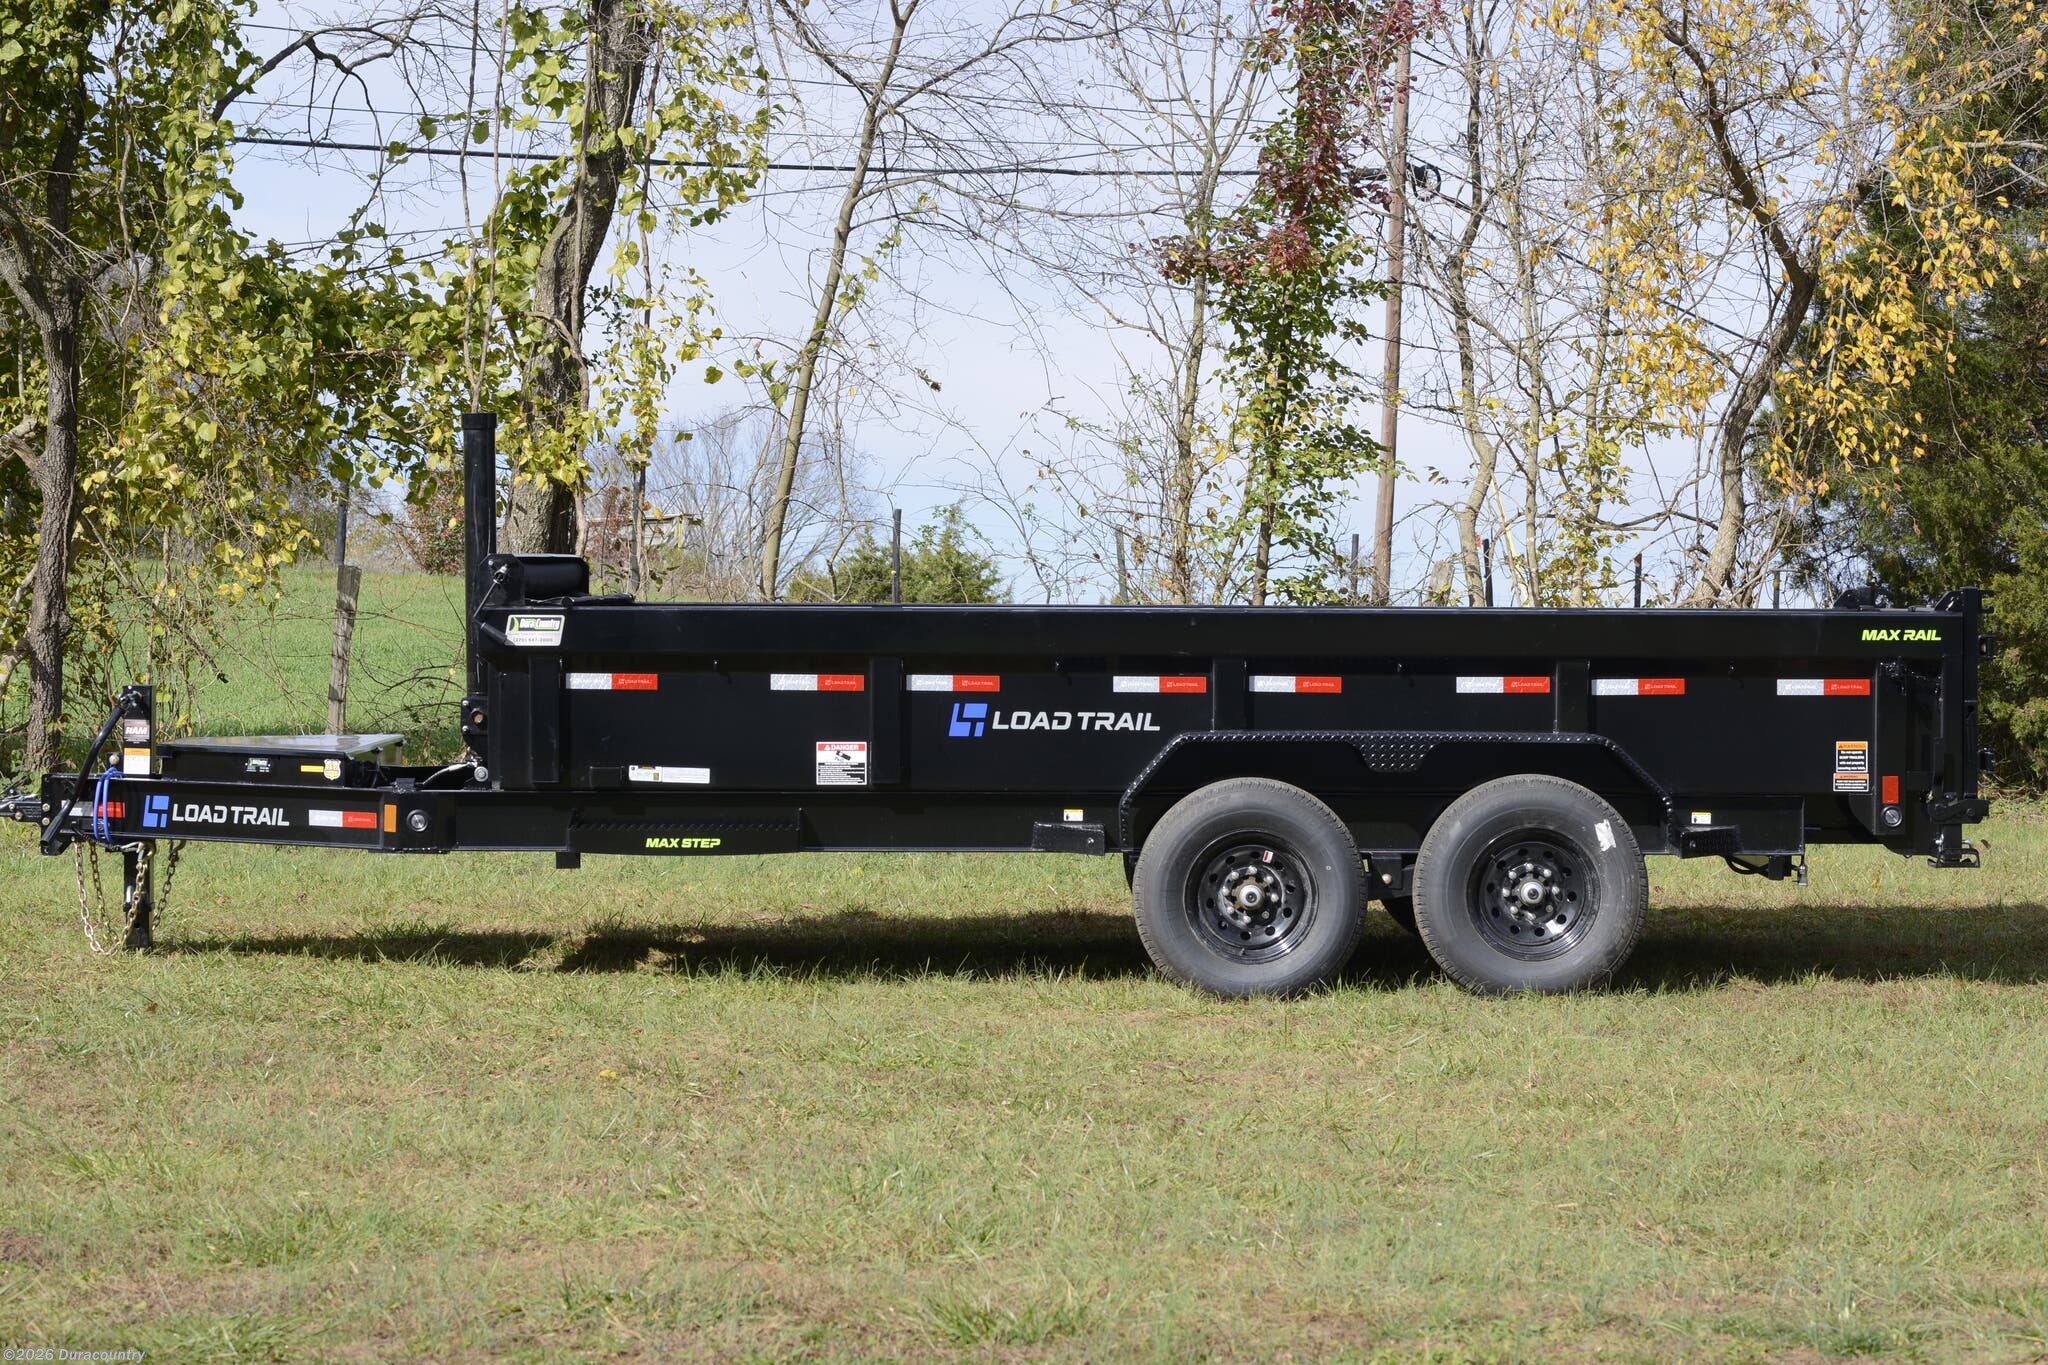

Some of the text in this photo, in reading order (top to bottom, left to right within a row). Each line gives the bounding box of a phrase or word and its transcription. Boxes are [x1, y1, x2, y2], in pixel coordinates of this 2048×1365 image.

[1862, 630, 1942, 640] MAX RAIL
[991, 711, 1162, 732] LOAD TRAIL
[126, 726, 148, 734] RAM
[171, 803, 228, 824] LOAD
[230, 805, 290, 827] TRAIL
[645, 838, 721, 848] MAX STEP
